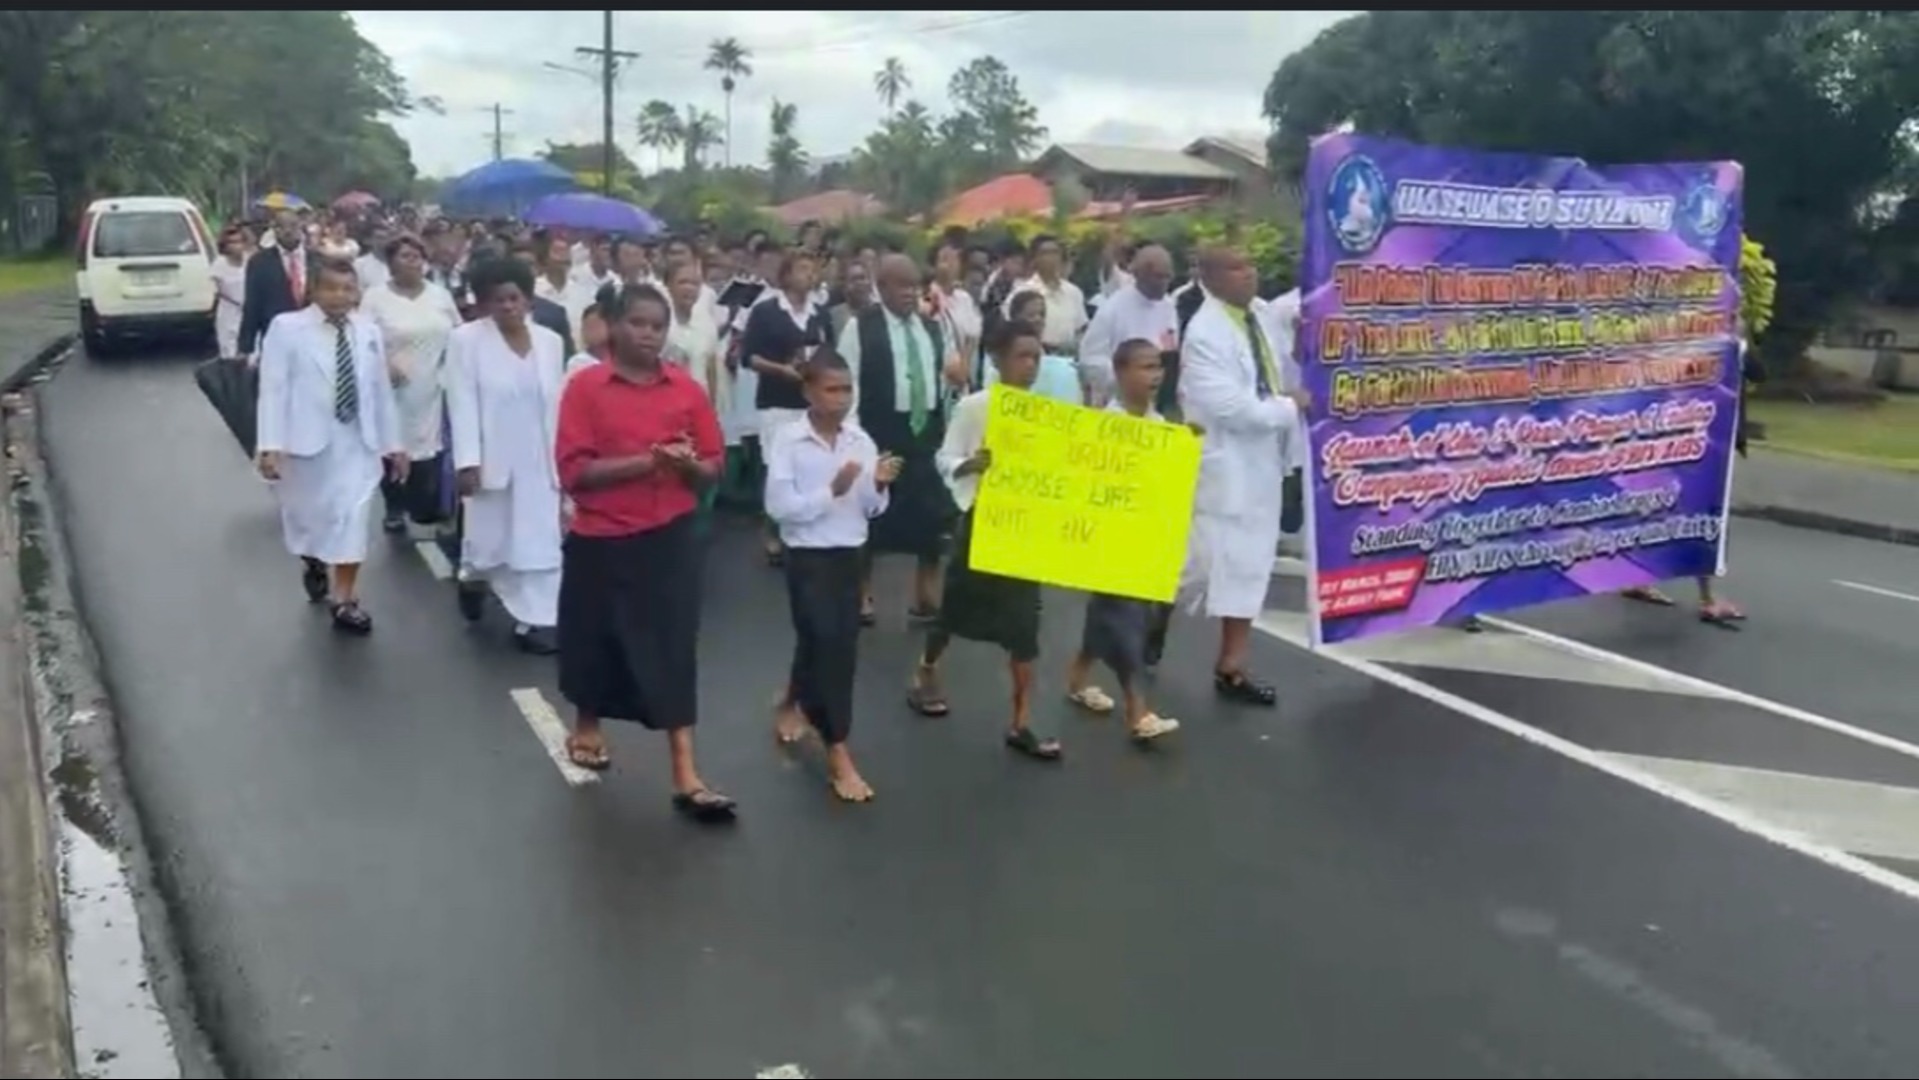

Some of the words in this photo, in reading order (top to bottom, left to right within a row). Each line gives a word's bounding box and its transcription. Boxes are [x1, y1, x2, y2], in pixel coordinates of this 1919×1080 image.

[986, 466, 1070, 501] CHOOSE
[1089, 483, 1141, 513] LIFE
[1352, 518, 1440, 553] Standing
